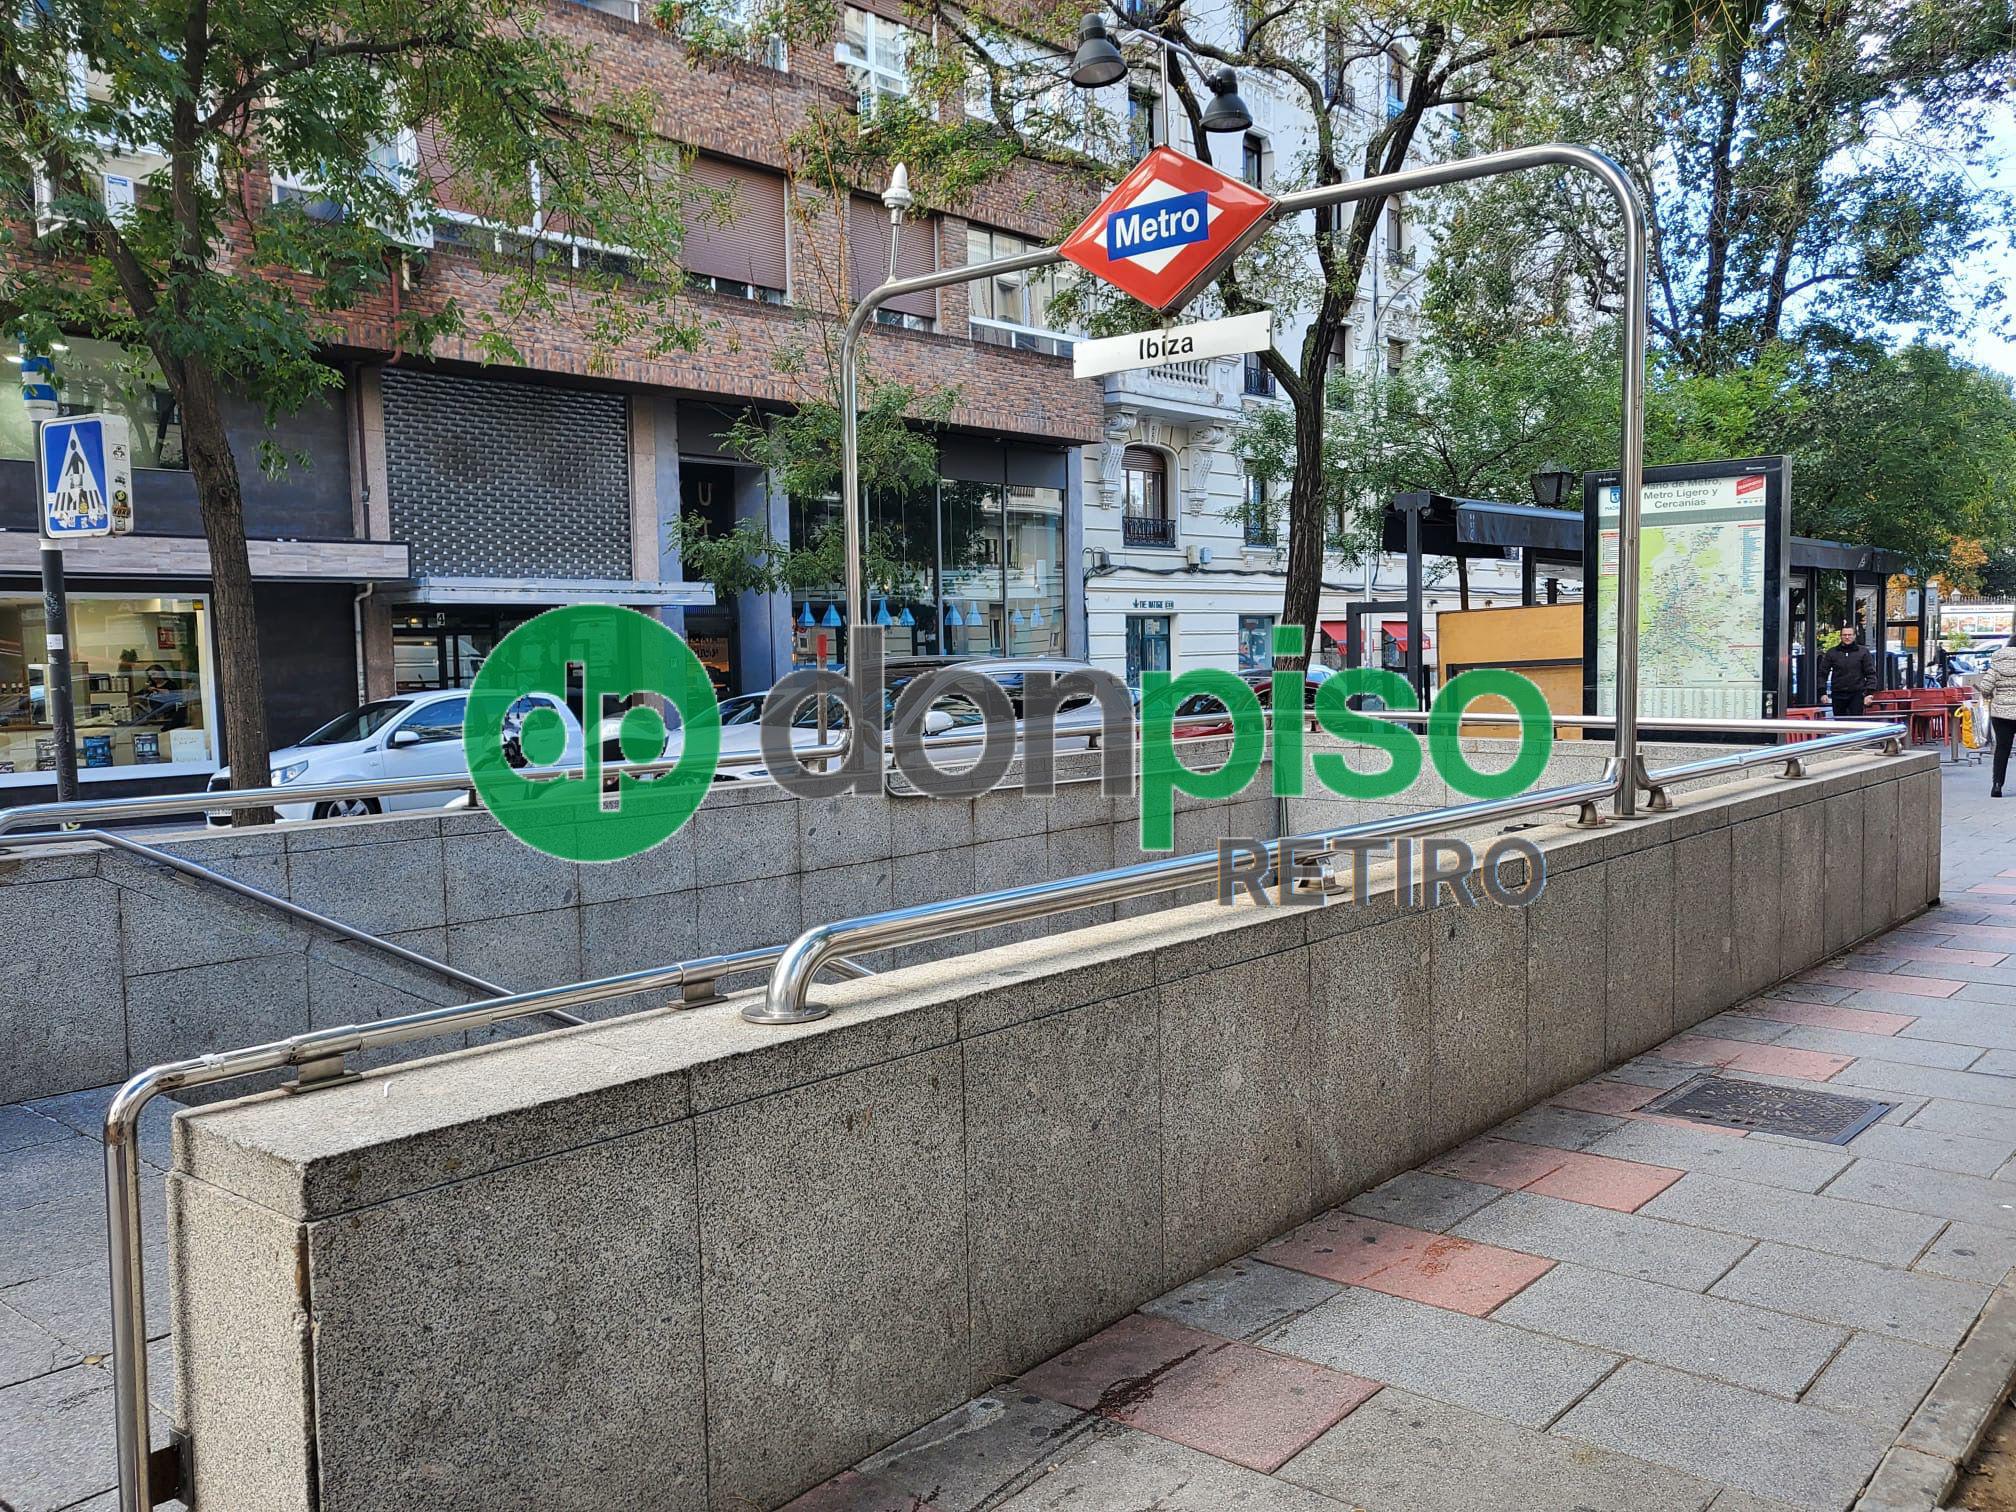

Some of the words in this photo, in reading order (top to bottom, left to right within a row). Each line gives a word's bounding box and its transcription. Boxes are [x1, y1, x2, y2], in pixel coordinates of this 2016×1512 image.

[1115, 207, 1200, 248] Metro
[1139, 335, 1194, 360] Ibiza
[1643, 491, 1674, 500] Metro
[1676, 488, 1709, 499] Ligero
[1711, 488, 1718, 496] y
[1654, 498, 1707, 509] Cercanías
[437, 613, 445, 625] 4
